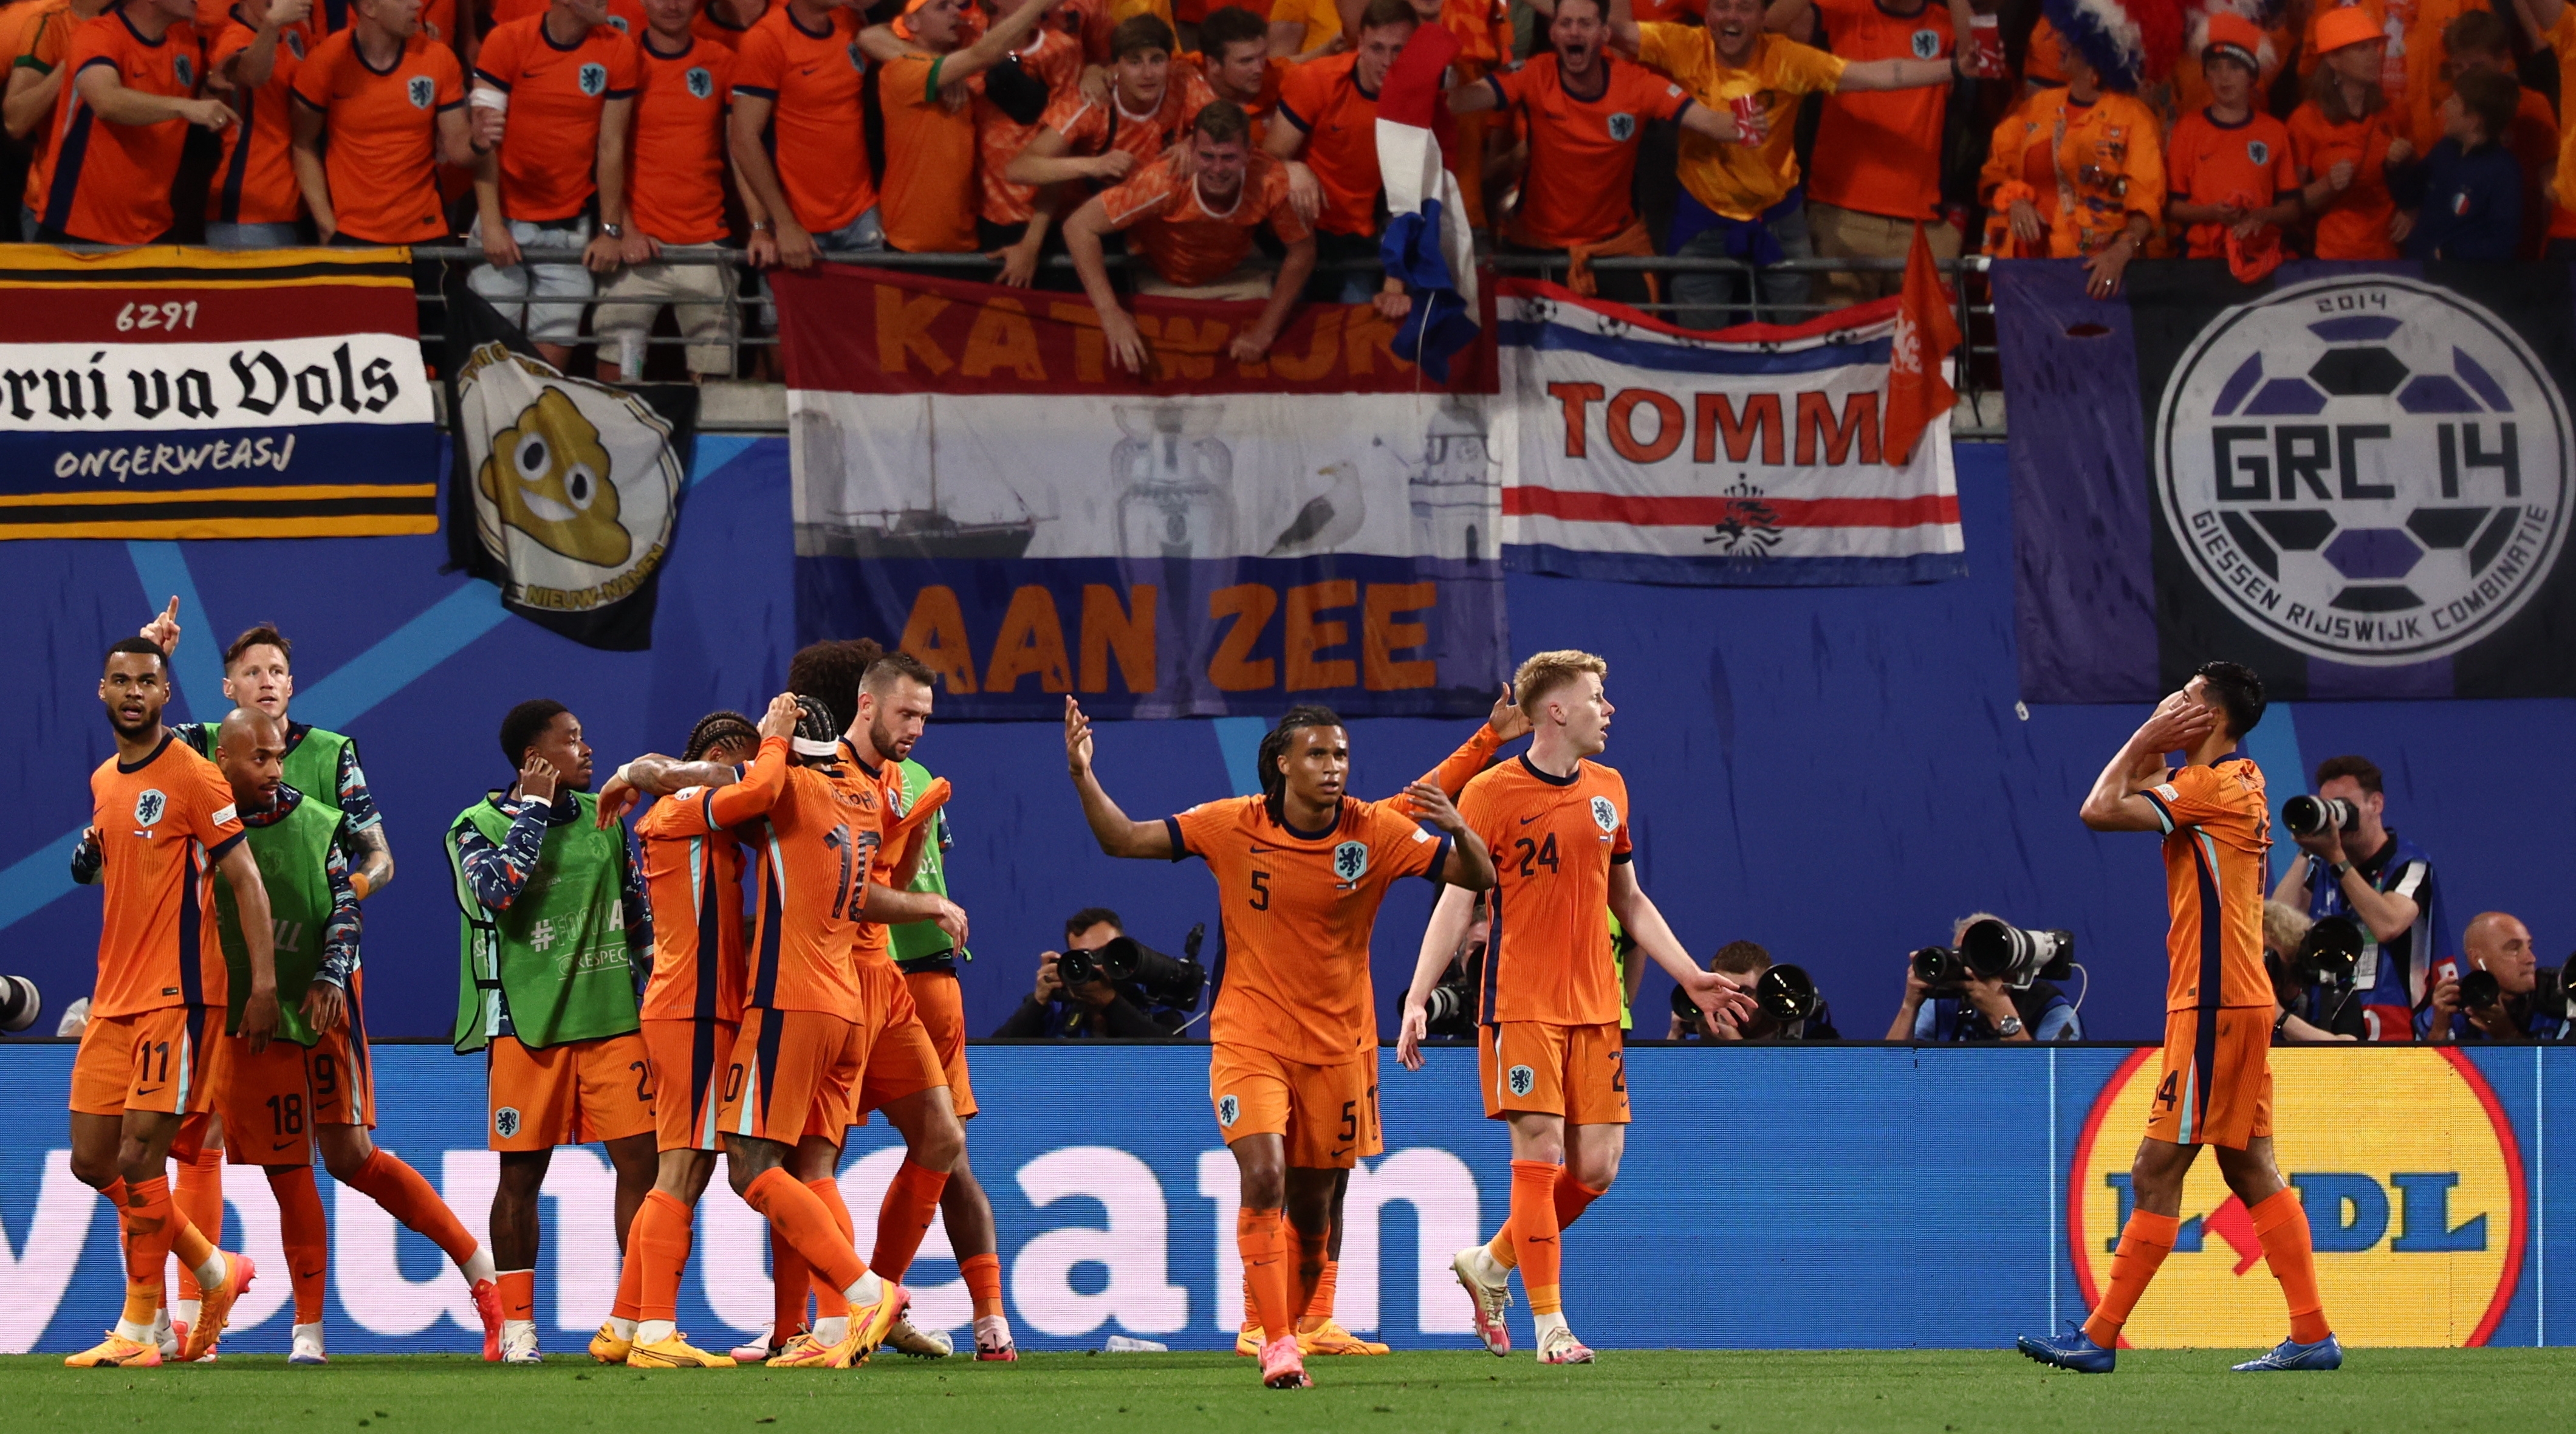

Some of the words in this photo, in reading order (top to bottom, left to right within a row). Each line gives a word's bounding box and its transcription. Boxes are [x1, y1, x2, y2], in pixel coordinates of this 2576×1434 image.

[116, 301, 197, 331] 6291
[2316, 293, 2388, 314] 2014
[874, 283, 1416, 384] KATWJK
[0, 351, 112, 420] rui
[128, 368, 219, 420] va
[229, 341, 400, 417] Vols
[1547, 380, 1909, 467] TOMM
[55, 434, 295, 482] ONGERWEASJ
[2212, 424, 2395, 503] GRC
[2437, 422, 2521, 499] 14
[524, 544, 664, 608] NIEUW-NAMEN
[2192, 509, 2282, 611] GIESSEN
[2286, 603, 2423, 644] RIJSWIJK
[2432, 504, 2550, 634] COMBINATIE
[900, 584, 1156, 696] AAN
[1208, 579, 1436, 694] ZEE
[823, 823, 882, 923] 10
[1515, 833, 1560, 877] 24
[1249, 871, 1270, 911] 5
[141, 1040, 169, 1083] 11
[315, 1054, 335, 1094] 9
[629, 1058, 656, 1102] 2
[2152, 1070, 2179, 1111] 4
[266, 1094, 303, 1135] 18
[1338, 1100, 1356, 1141] 5
